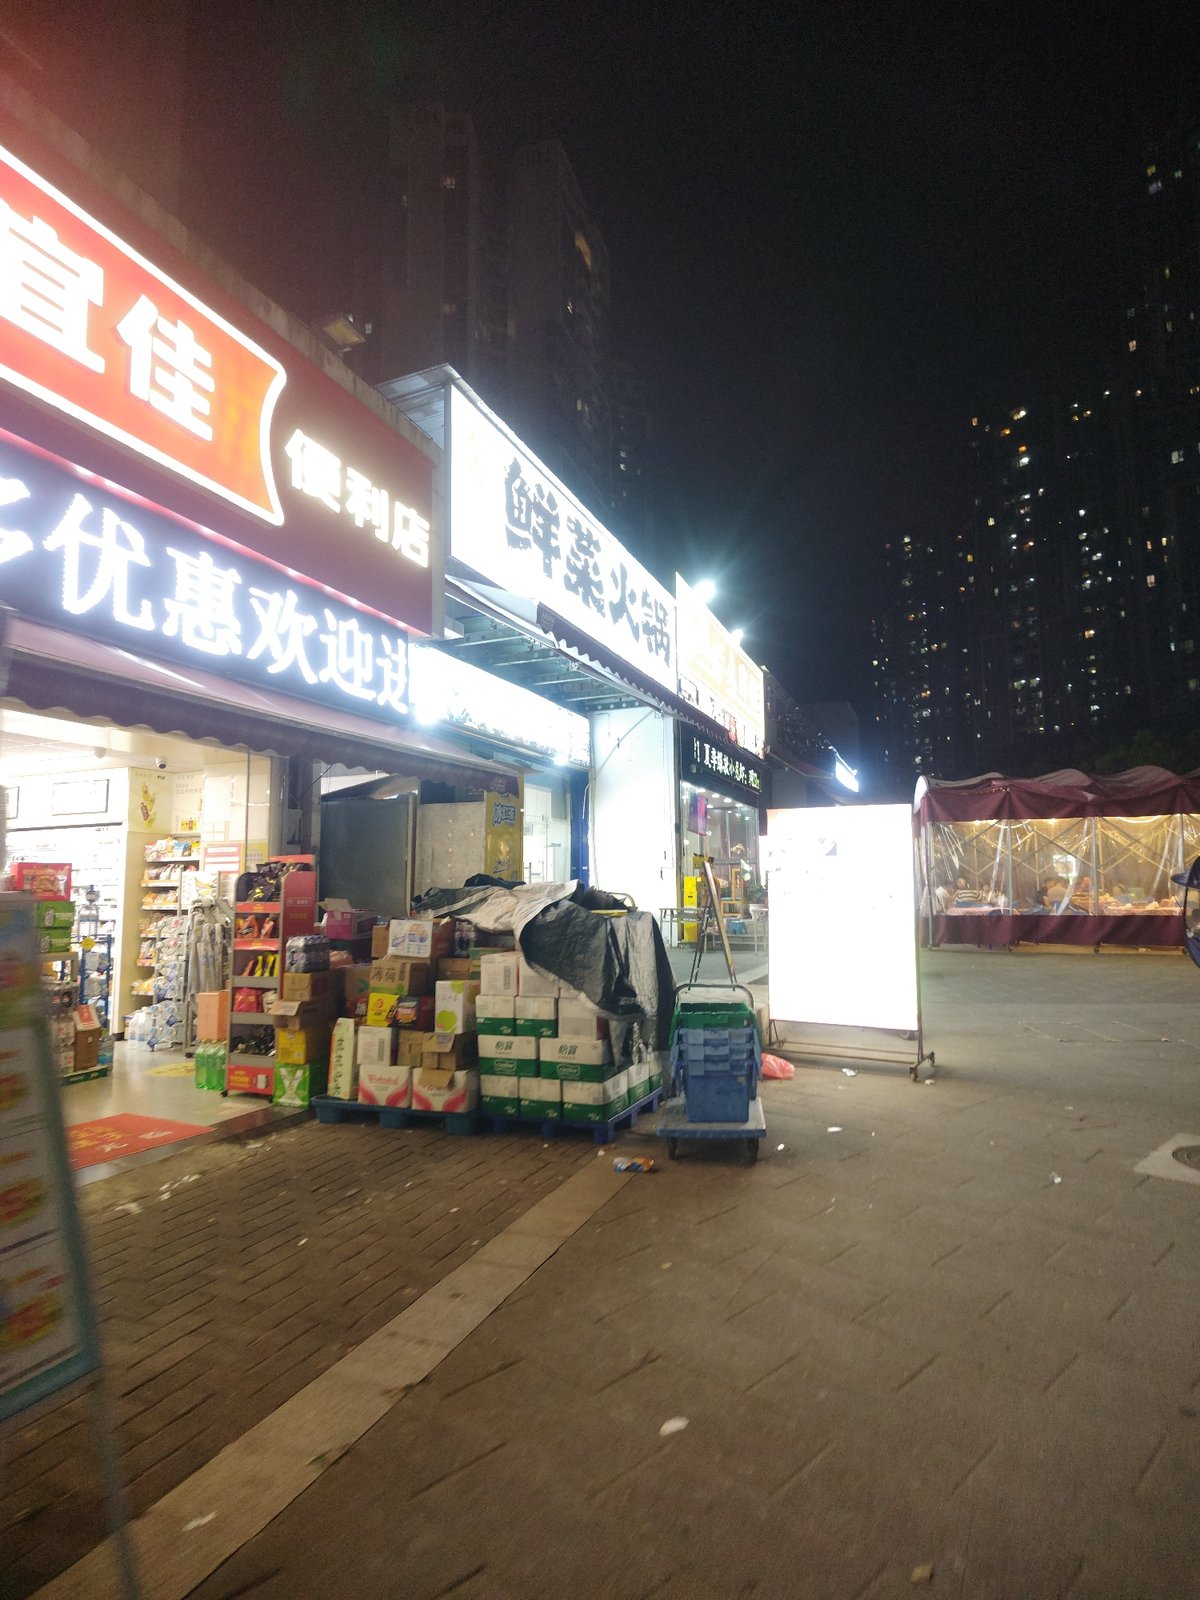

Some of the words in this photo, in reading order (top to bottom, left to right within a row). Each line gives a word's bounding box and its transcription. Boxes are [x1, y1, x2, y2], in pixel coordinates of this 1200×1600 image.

[285, 428, 430, 568] 便利店
[504, 456, 671, 667] 鲜菜火锅
